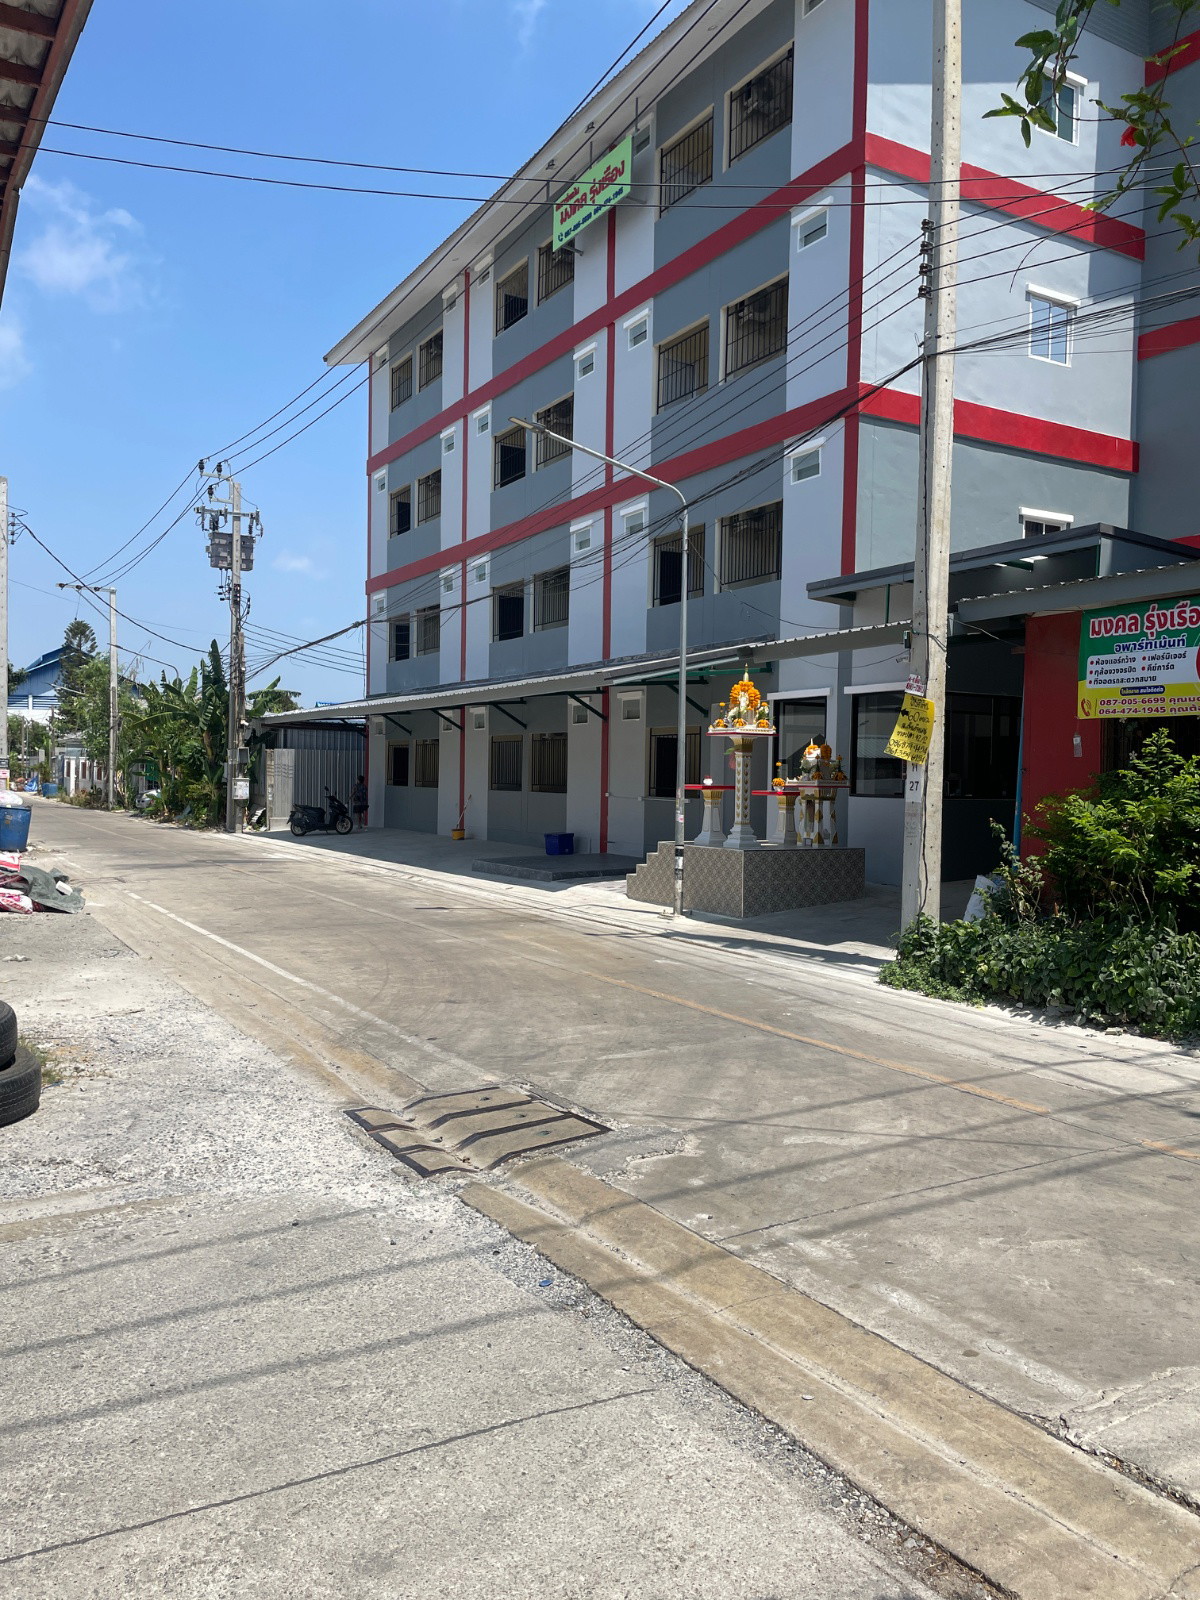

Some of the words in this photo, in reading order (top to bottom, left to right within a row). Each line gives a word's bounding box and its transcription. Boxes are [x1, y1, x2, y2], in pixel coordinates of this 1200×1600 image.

[1090, 614, 1140, 638] มงคล
[1099, 697, 1166, 706] 087-005-6699
[1098, 706, 1166, 715] 064-474-1945
[909, 781, 919, 791] 27
